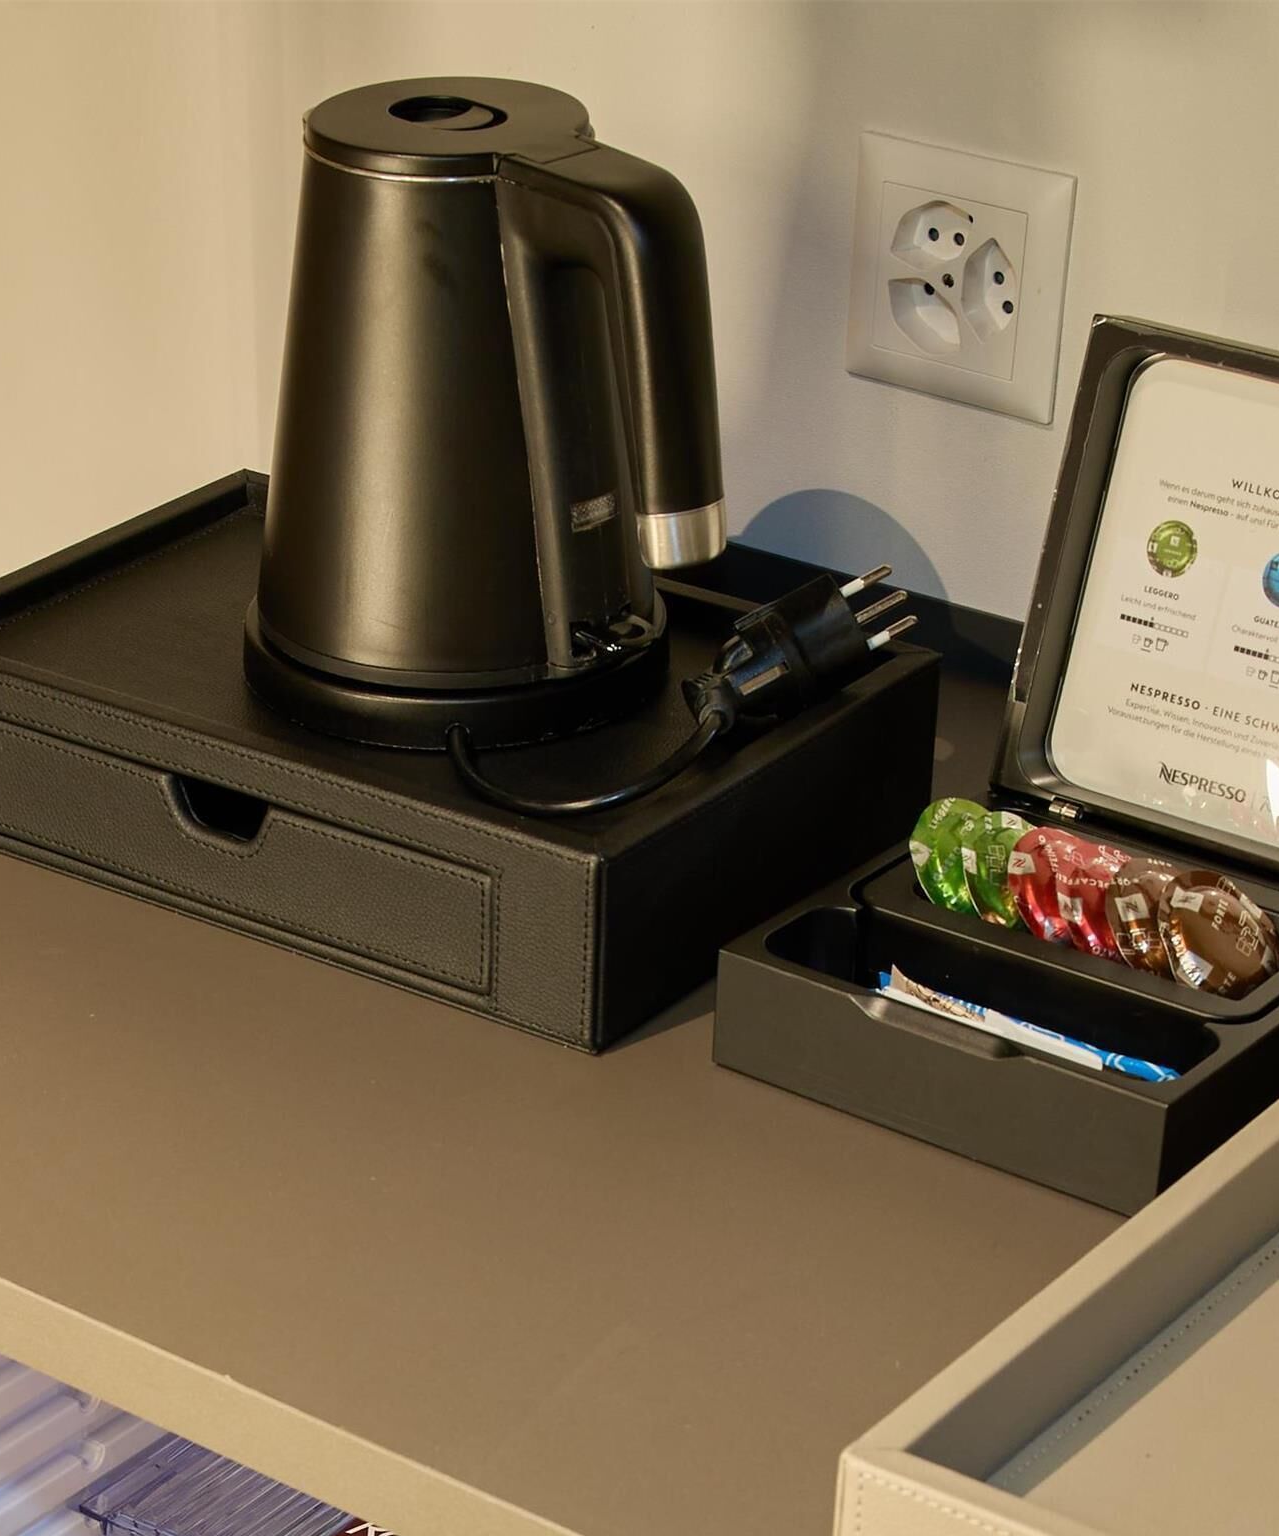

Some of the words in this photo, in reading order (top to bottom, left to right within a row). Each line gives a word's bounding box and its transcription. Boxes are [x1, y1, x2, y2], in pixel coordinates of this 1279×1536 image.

[1192, 486, 1215, 500] darum
[1190, 500, 1229, 517] Nespresso
[1144, 586, 1179, 601] LEGGERO
[1130, 683, 1201, 710] NESPRESSO
[1213, 706, 1242, 723] EINE
[1159, 761, 1247, 804] NESPRESSO
